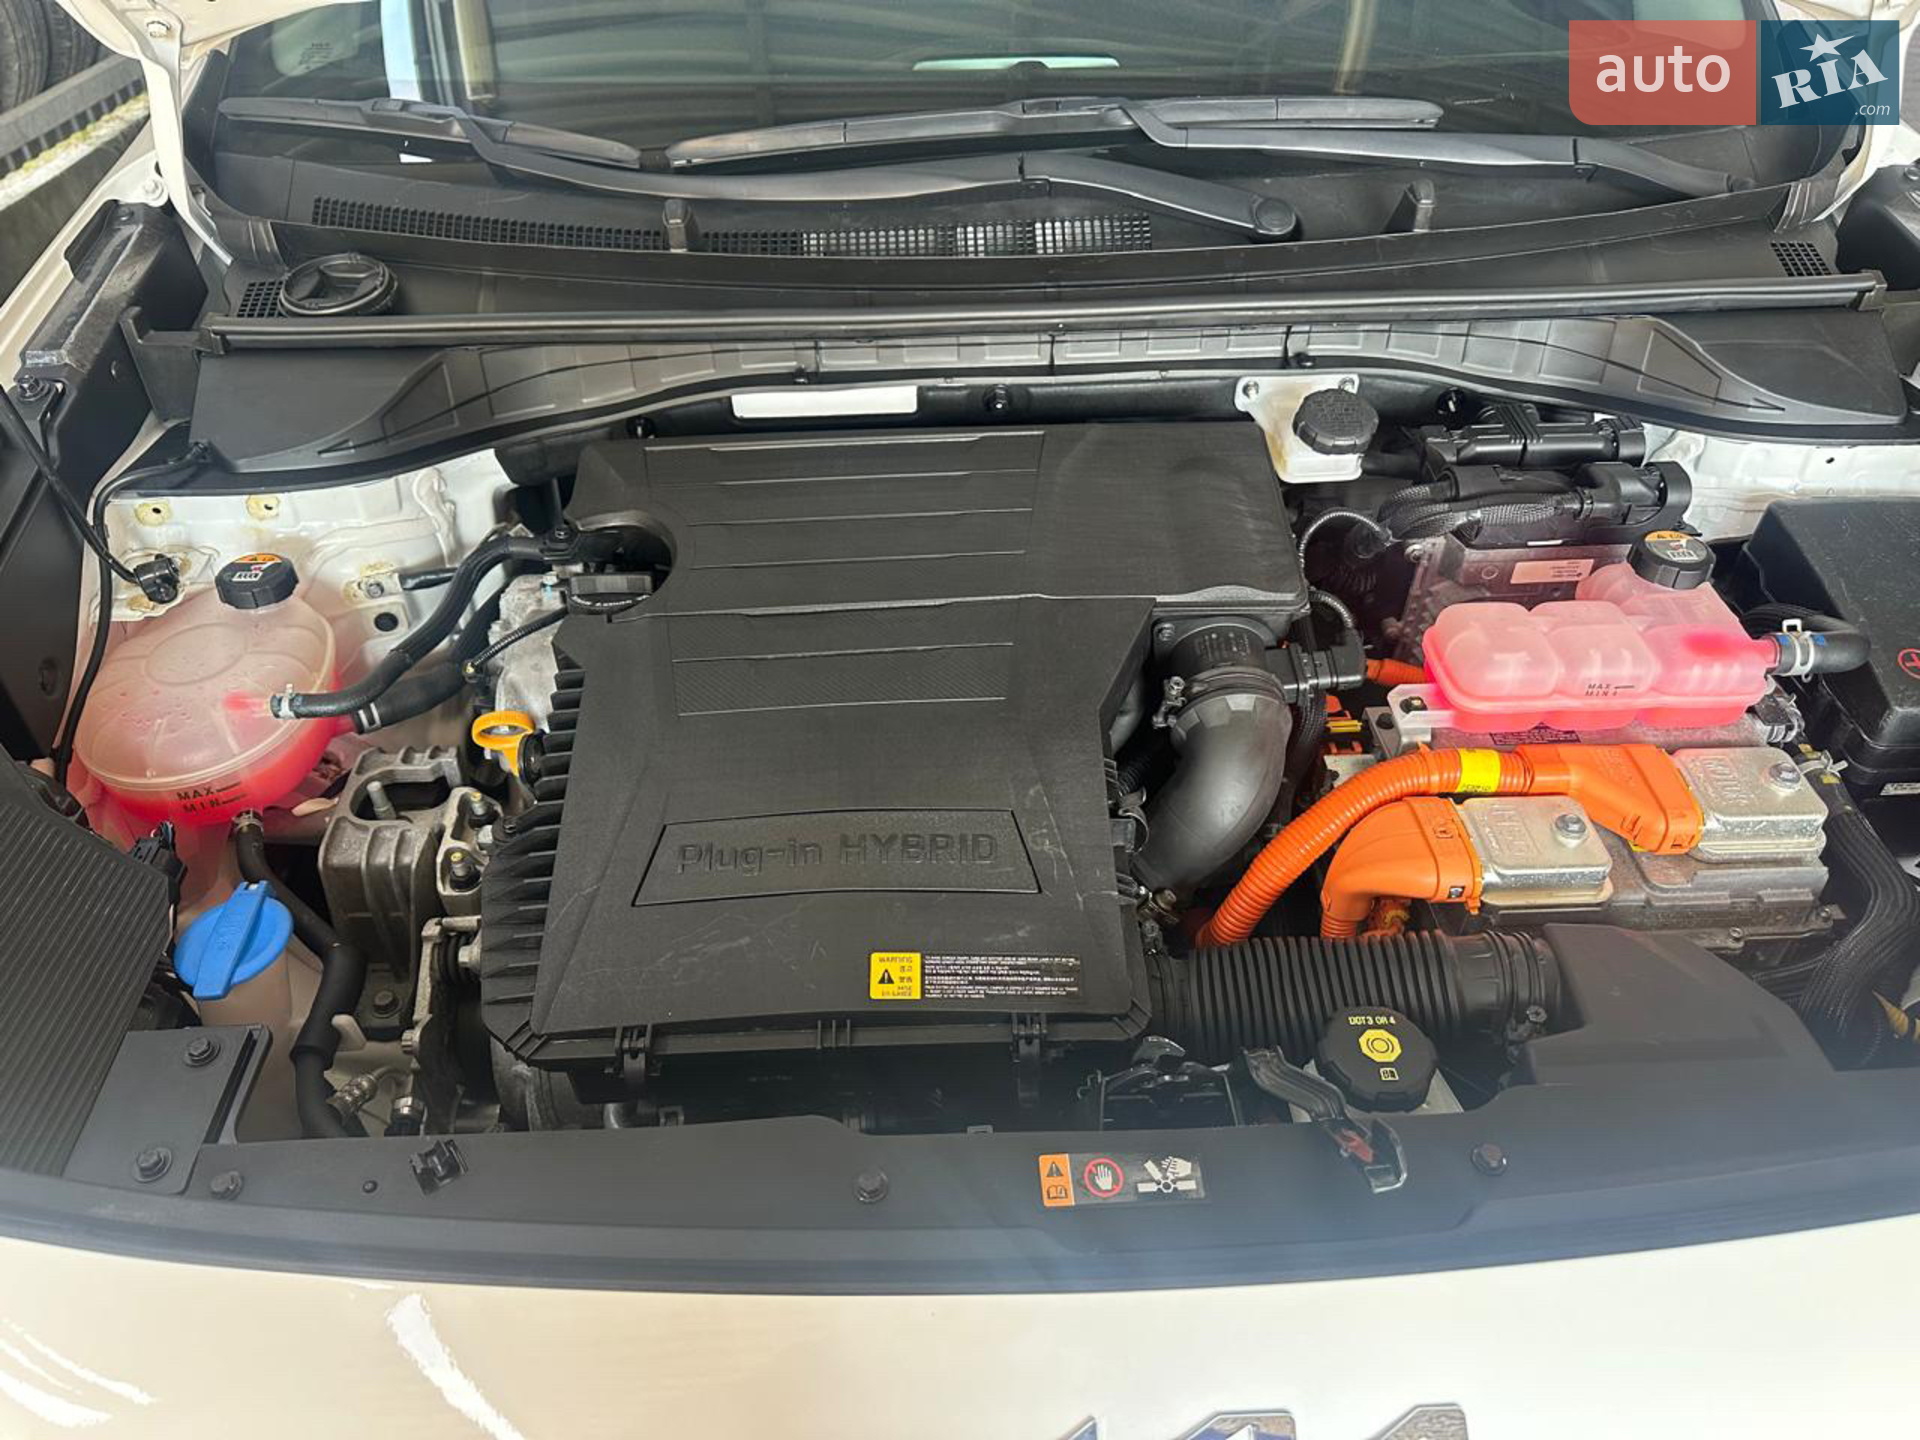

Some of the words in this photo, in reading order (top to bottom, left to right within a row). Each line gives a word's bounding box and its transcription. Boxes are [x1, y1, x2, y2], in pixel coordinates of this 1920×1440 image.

[176, 787, 214, 801] MAX
[183, 798, 221, 812] MIN
[677, 839, 823, 876] Plug-in
[839, 832, 998, 865] HYBRID
[1375, 1016, 1388, 1025] OR
[1389, 1016, 1397, 1025] 4
